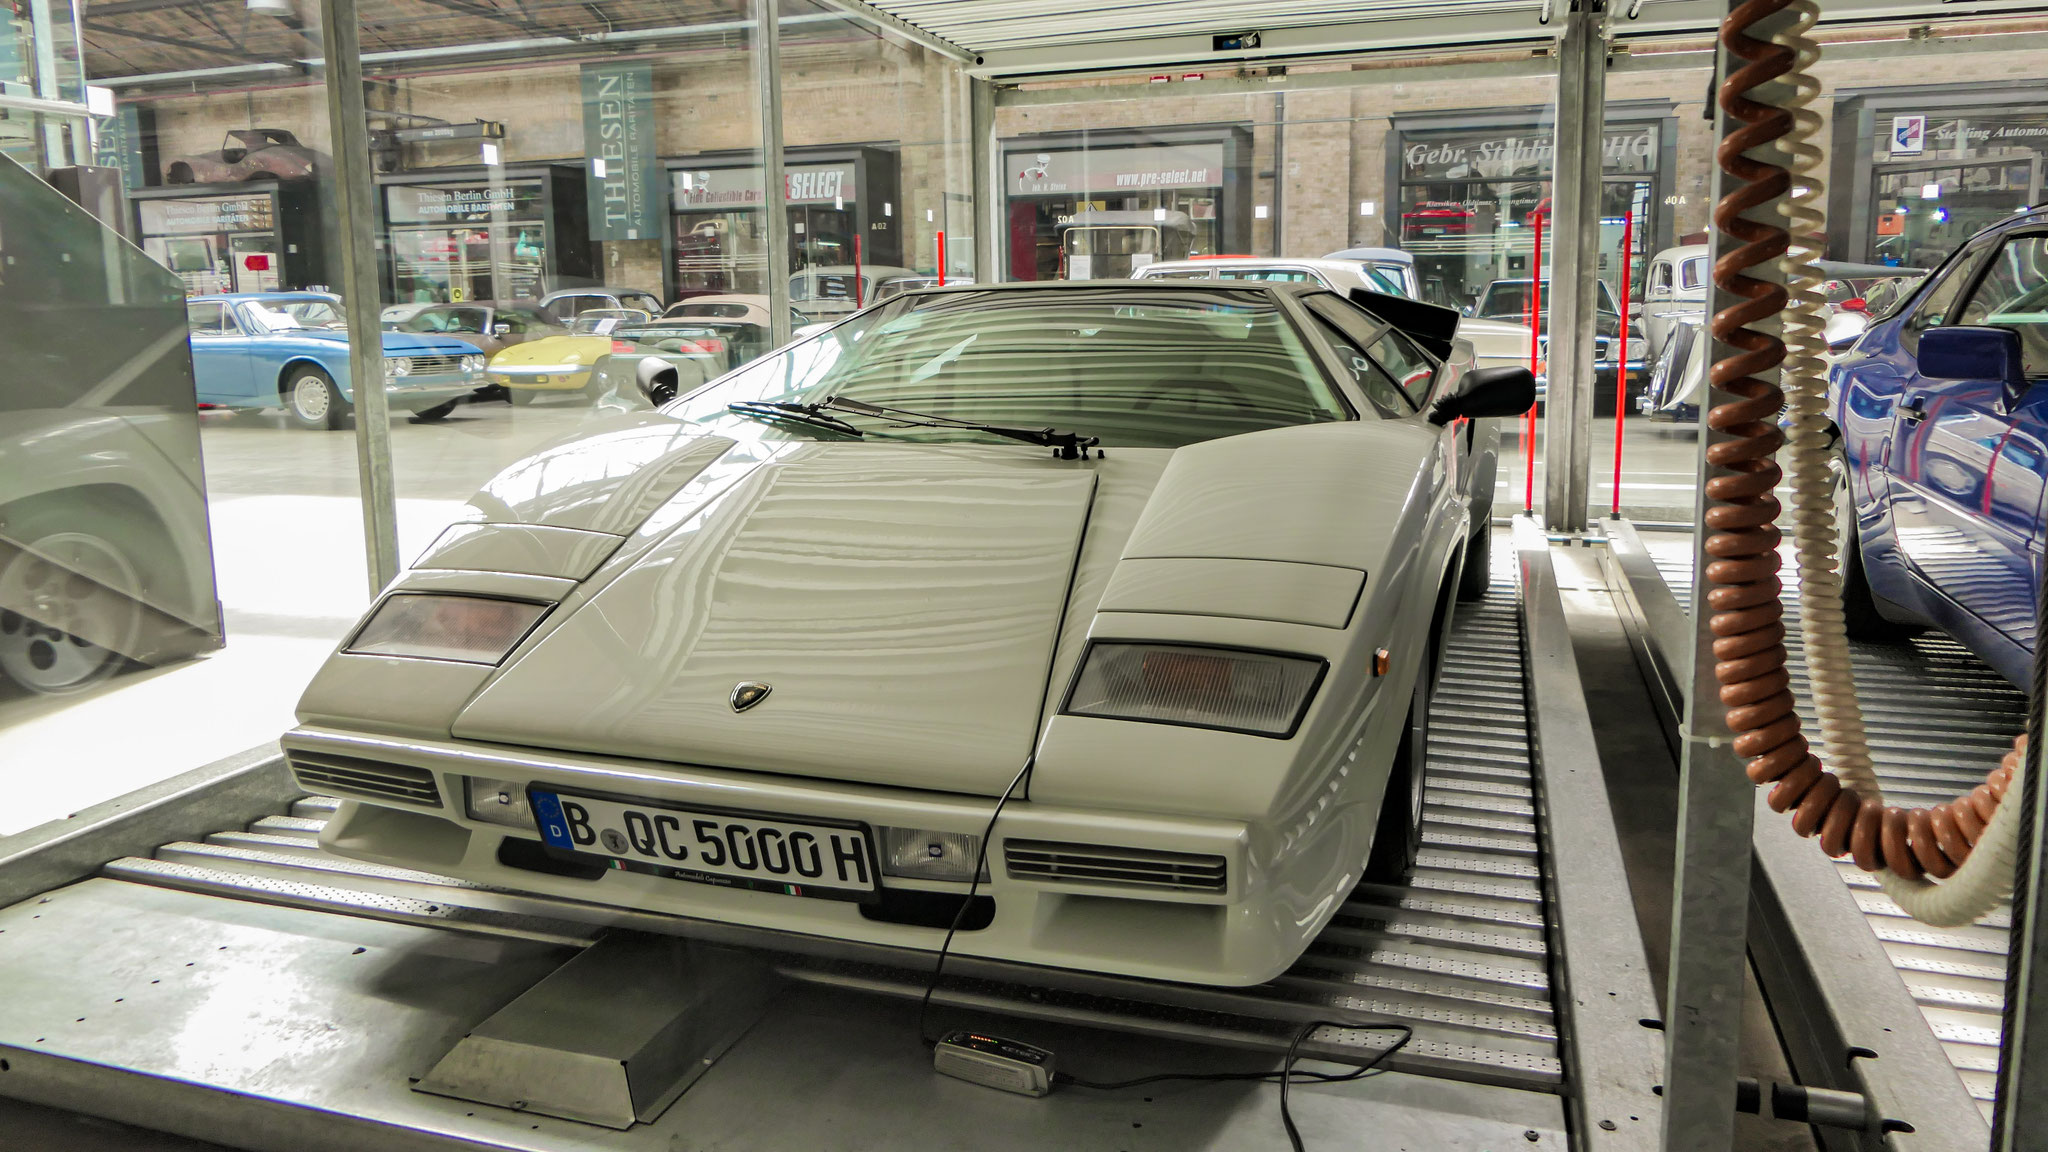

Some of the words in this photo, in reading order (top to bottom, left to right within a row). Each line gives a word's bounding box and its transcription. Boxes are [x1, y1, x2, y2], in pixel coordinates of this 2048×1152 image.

[1935, 126, 1991, 141] Steling
[598, 75, 628, 228] THIESEN
[1408, 143, 1468, 165] Gebr.
[630, 144, 642, 226] AUTOMOBILE
[791, 170, 845, 200] SELECT
[1116, 168, 1208, 188] www.pre-select.net
[417, 191, 452, 203] Thiesen
[454, 189, 482, 201] Berlin
[483, 188, 515, 200] GmbH
[418, 203, 470, 214] AUTOMOBILE
[550, 825, 562, 838] D
[561, 800, 597, 847] B
[623, 810, 689, 861] QC
[692, 819, 824, 878] 5000
[829, 834, 869, 884] H
